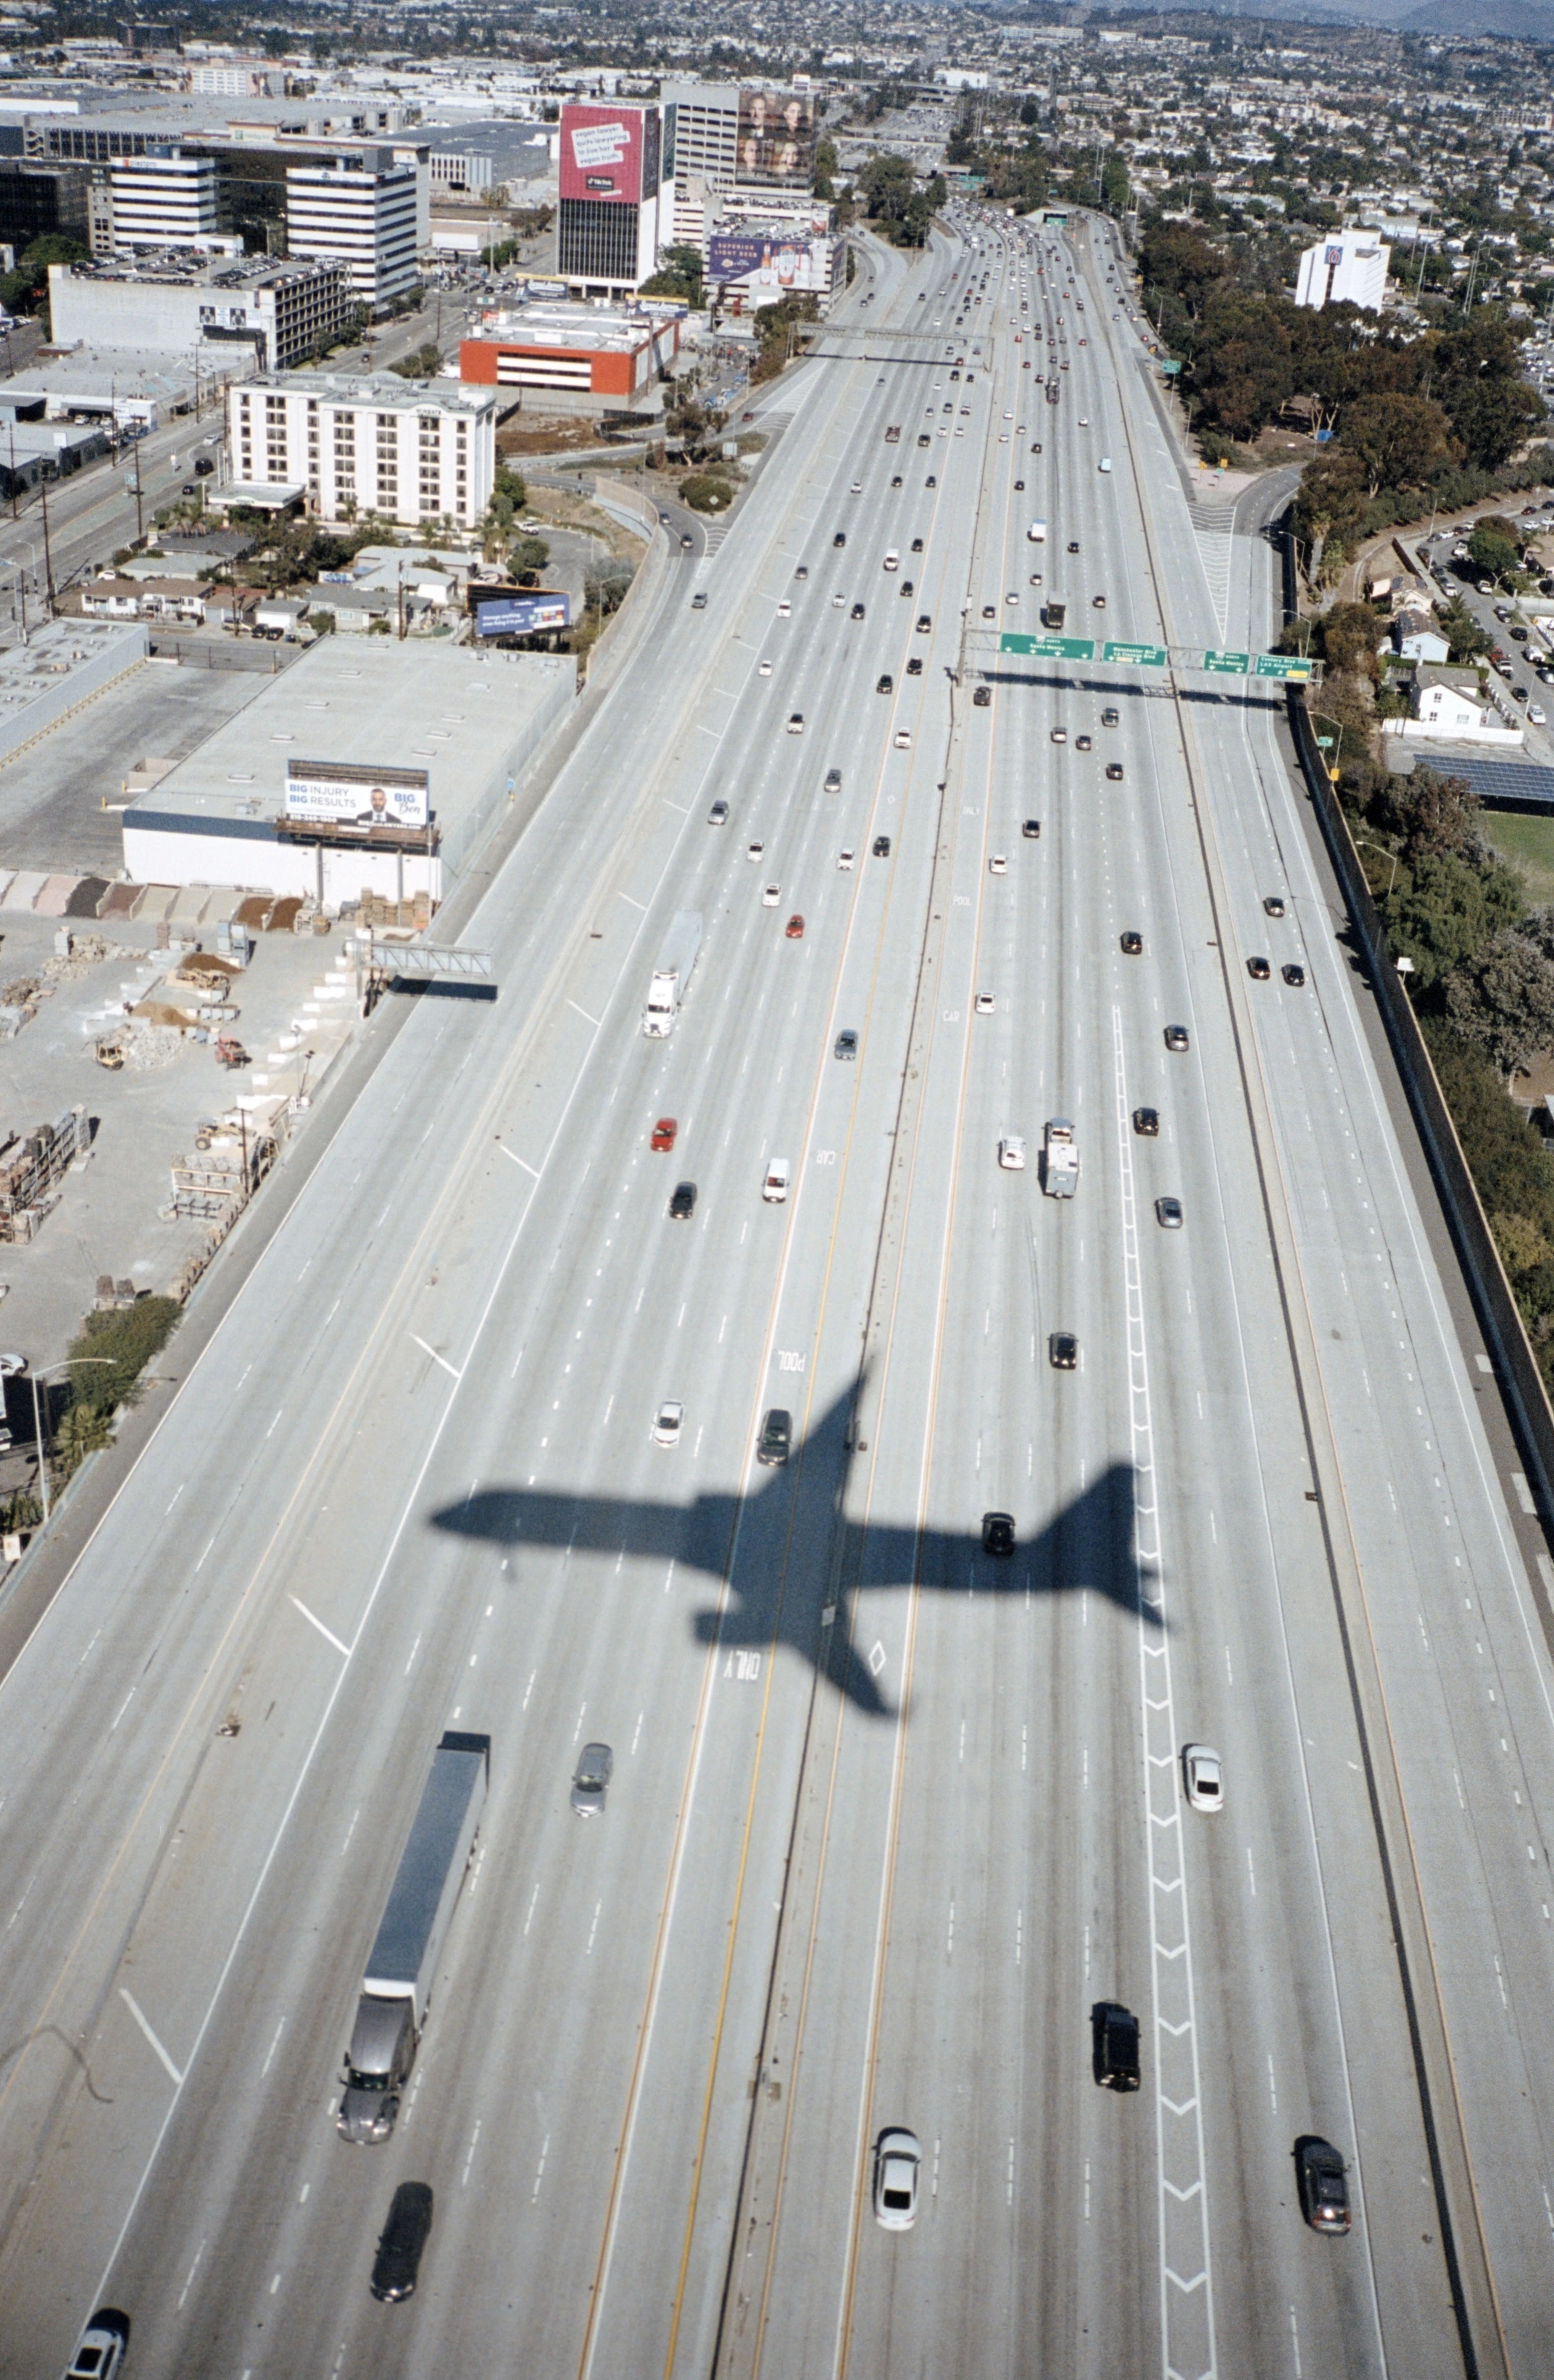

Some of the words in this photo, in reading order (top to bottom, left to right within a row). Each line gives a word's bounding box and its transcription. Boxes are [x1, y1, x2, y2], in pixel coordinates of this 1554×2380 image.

[594, 134, 628, 144] lawyering
[289, 784, 308, 793] BIG
[310, 785, 349, 797] INJURY
[289, 795, 308, 804] BIG
[310, 796, 357, 808] RESULTS
[394, 792, 415, 803] BIG
[398, 802, 421, 815] Ben
[963, 806, 980, 816] ONLY
[952, 895, 972, 905] POOL
[943, 1009, 960, 1023] CAR
[816, 1149, 836, 1165] CAR
[778, 1351, 807, 1373] POOL
[723, 1649, 761, 1680] ONLY
